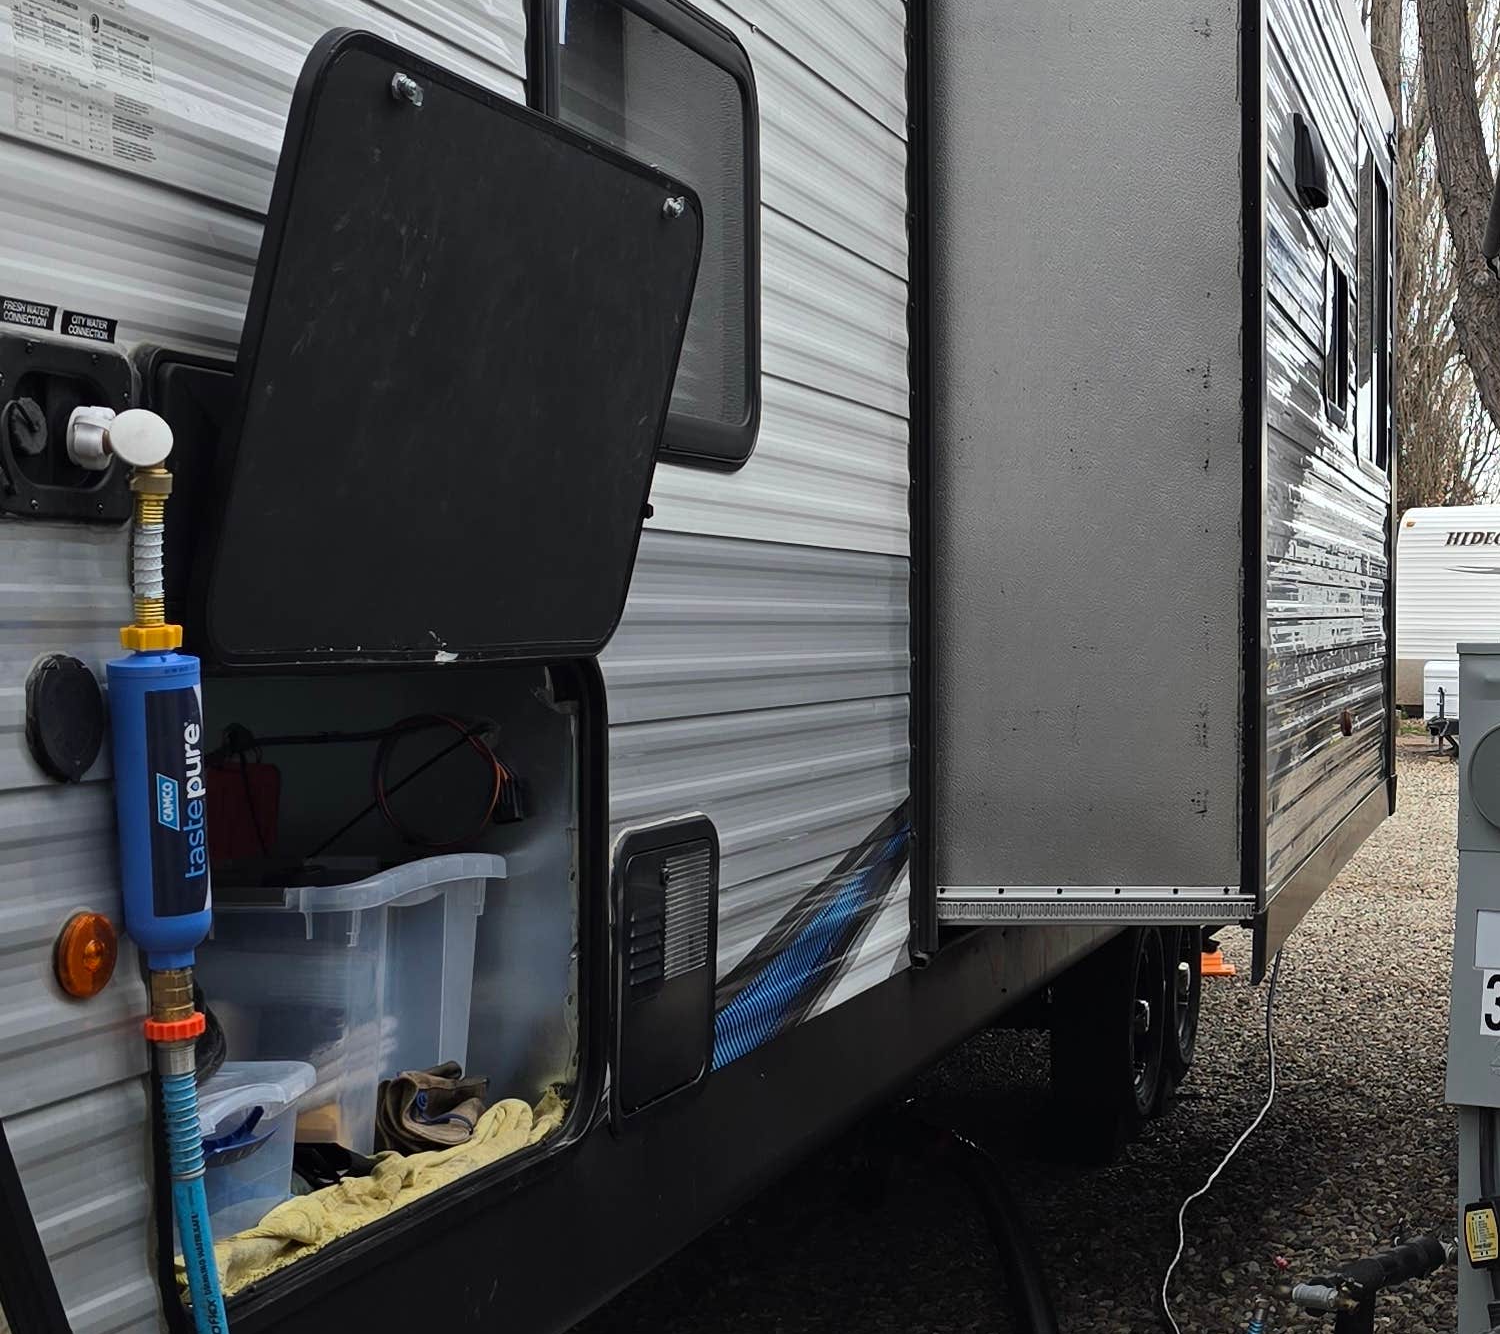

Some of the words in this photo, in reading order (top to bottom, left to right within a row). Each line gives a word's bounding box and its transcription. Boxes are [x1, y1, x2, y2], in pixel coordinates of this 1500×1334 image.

[3, 300, 25, 312] FRESH
[27, 305, 50, 317] WATER
[3, 310, 48, 327] CONNECTION
[71, 314, 86, 325] CITY
[87, 318, 108, 329] WATER
[68, 325, 108, 340] CONNECTION
[161, 780, 175, 823] CAMCO
